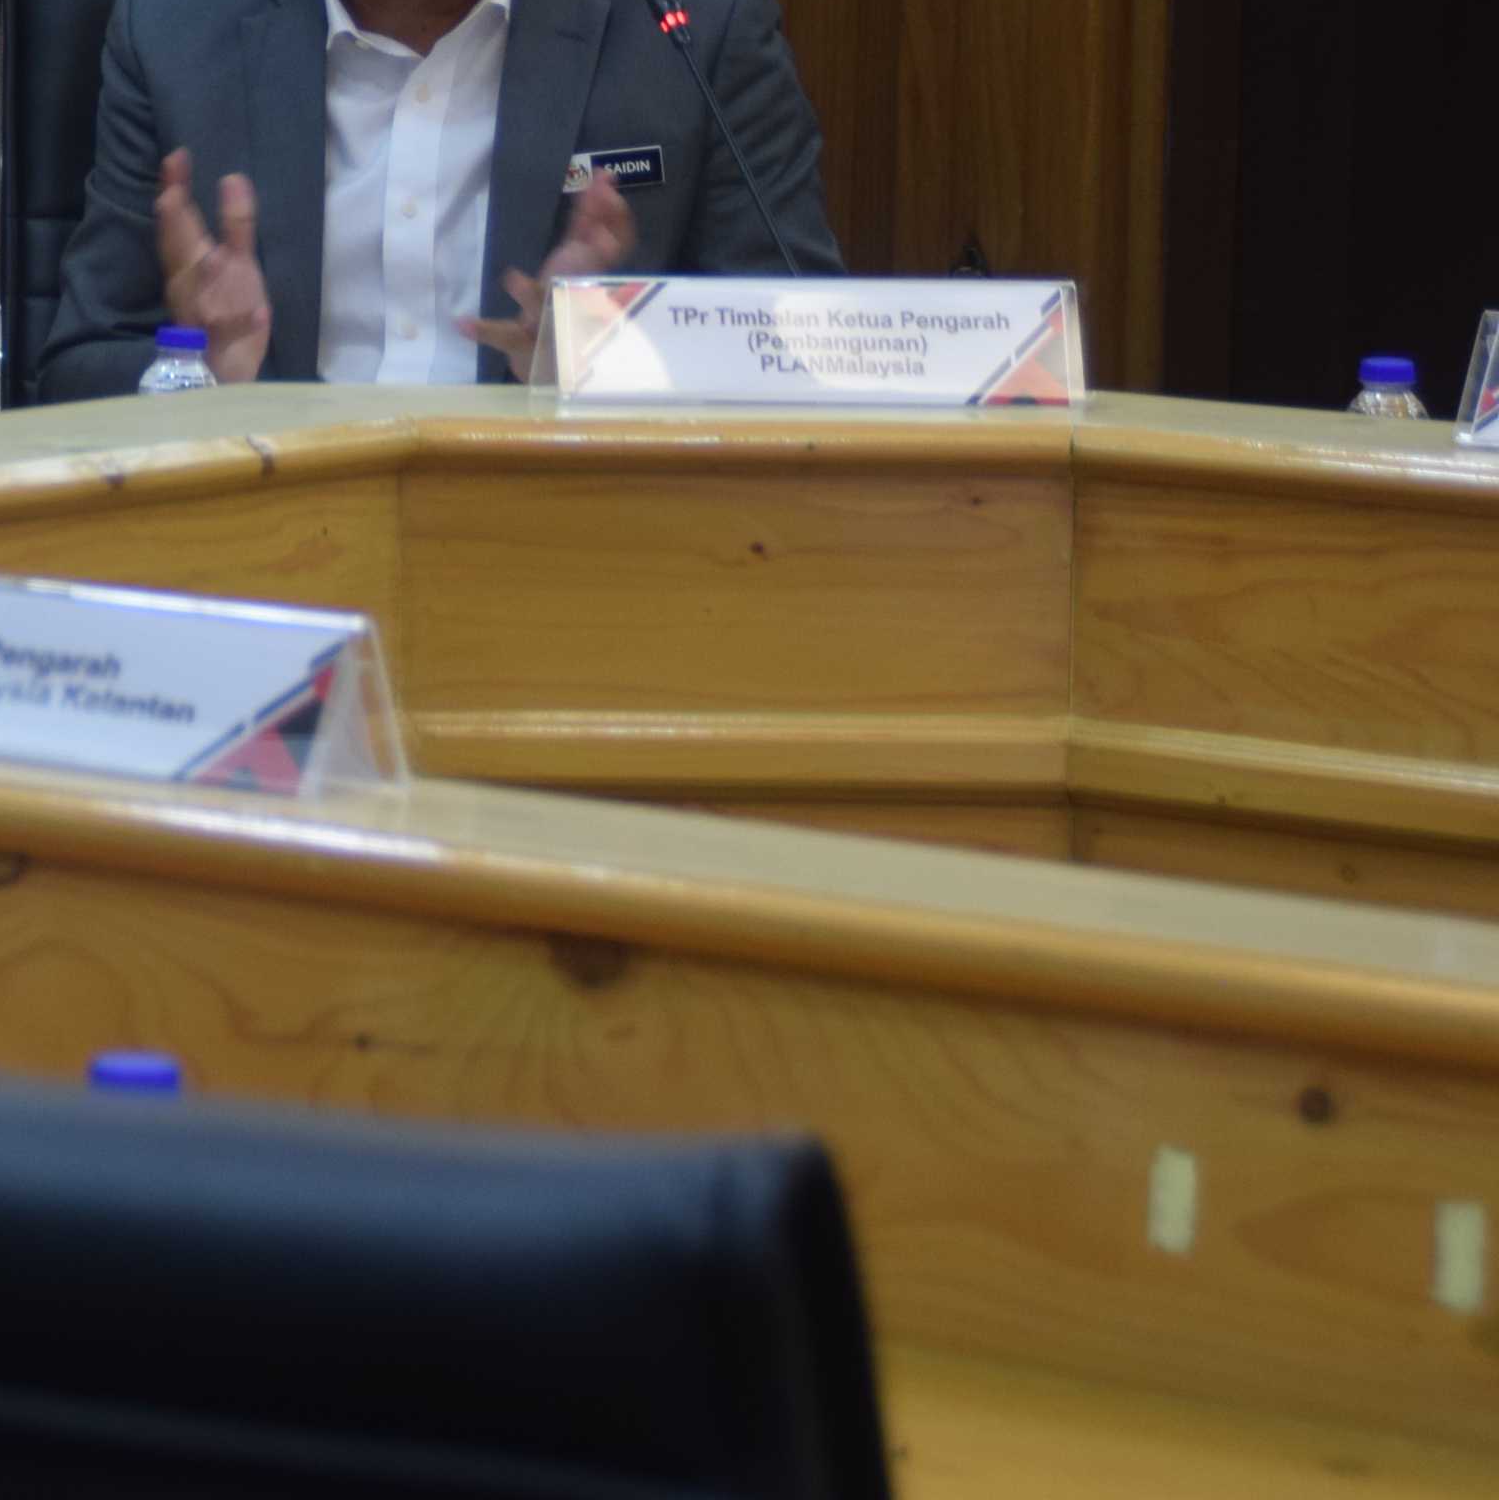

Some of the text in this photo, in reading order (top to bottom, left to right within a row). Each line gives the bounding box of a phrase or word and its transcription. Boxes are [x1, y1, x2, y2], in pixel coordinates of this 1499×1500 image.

[604, 159, 651, 174] SAIDIN
[669, 307, 1011, 335] TPr Timbalan Ketua Pengarah
[747, 330, 928, 357] (Pembangunan)
[760, 354, 925, 378] PLANMalaysia
[61, 683, 196, 724] Kelantan
